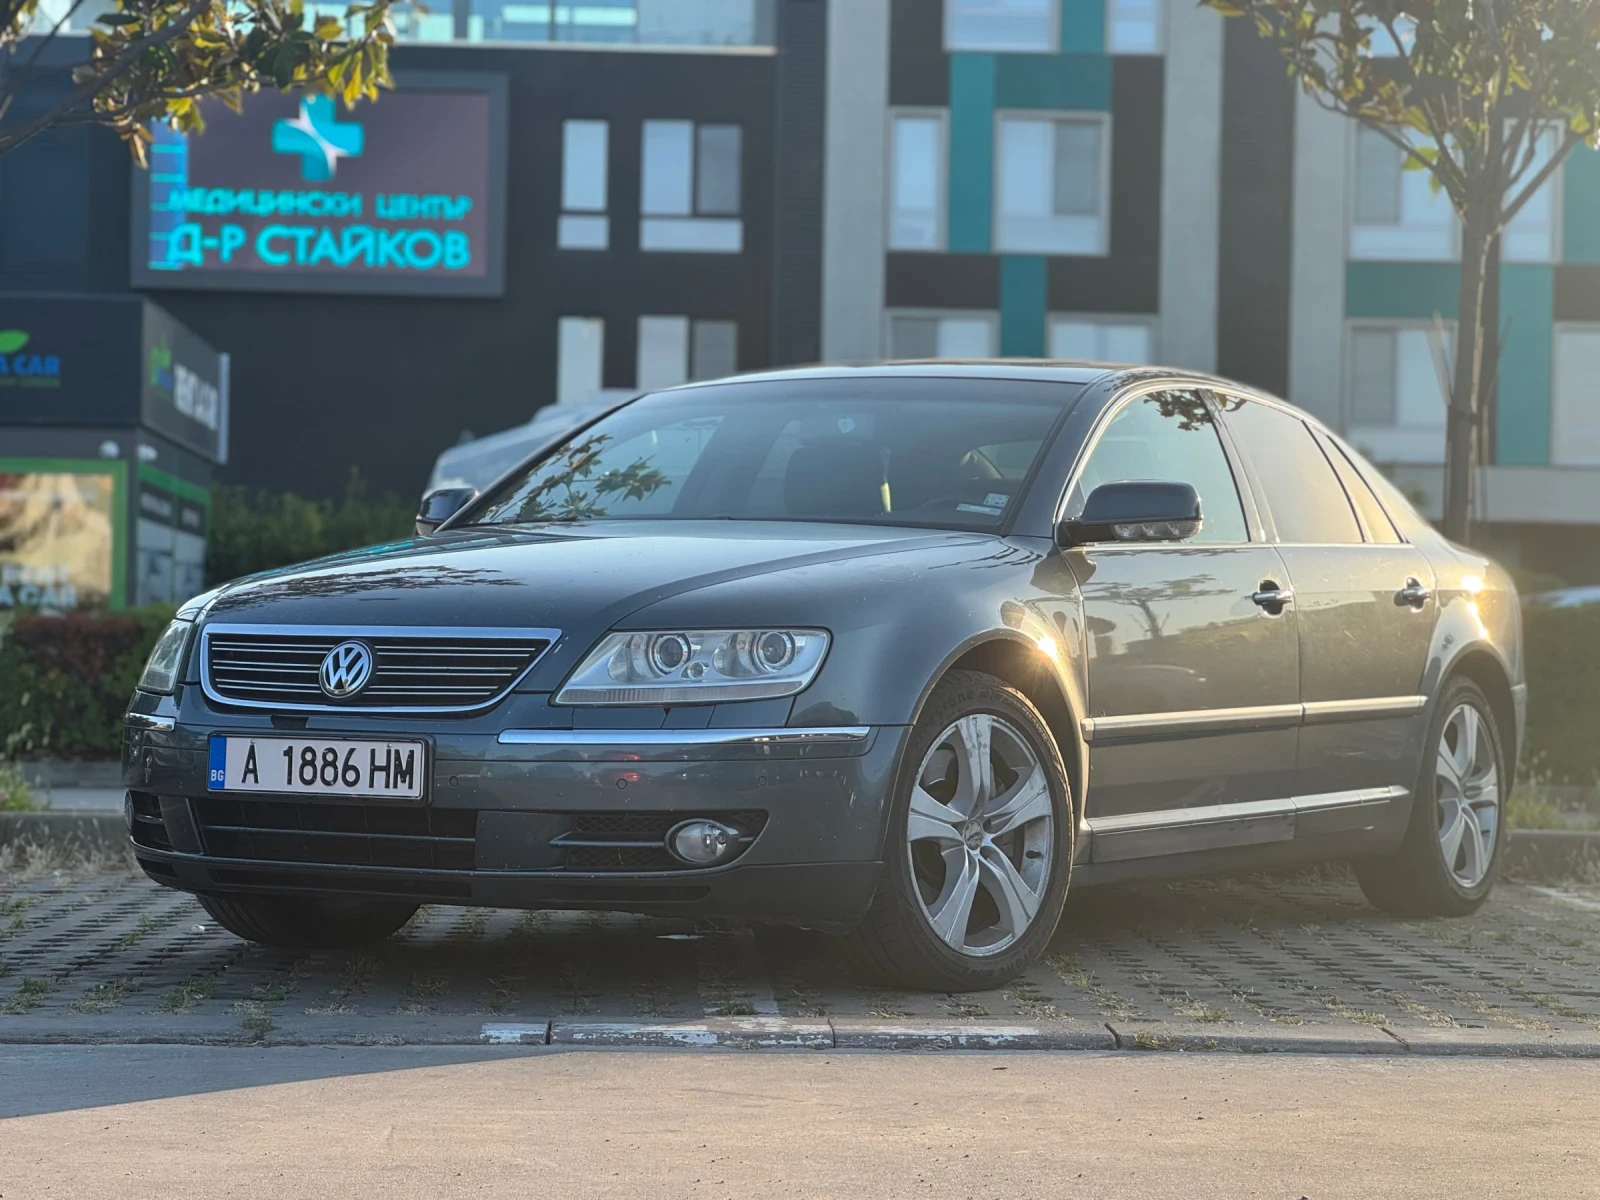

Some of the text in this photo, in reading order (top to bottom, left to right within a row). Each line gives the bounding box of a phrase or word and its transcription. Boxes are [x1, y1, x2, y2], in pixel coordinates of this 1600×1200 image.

[375, 192, 472, 220] ЦЕНТЪР
[165, 221, 471, 270] Д-Р СТАЙКОВ
[210, 769, 225, 782] BG
[241, 743, 415, 790] A 1886 HM
